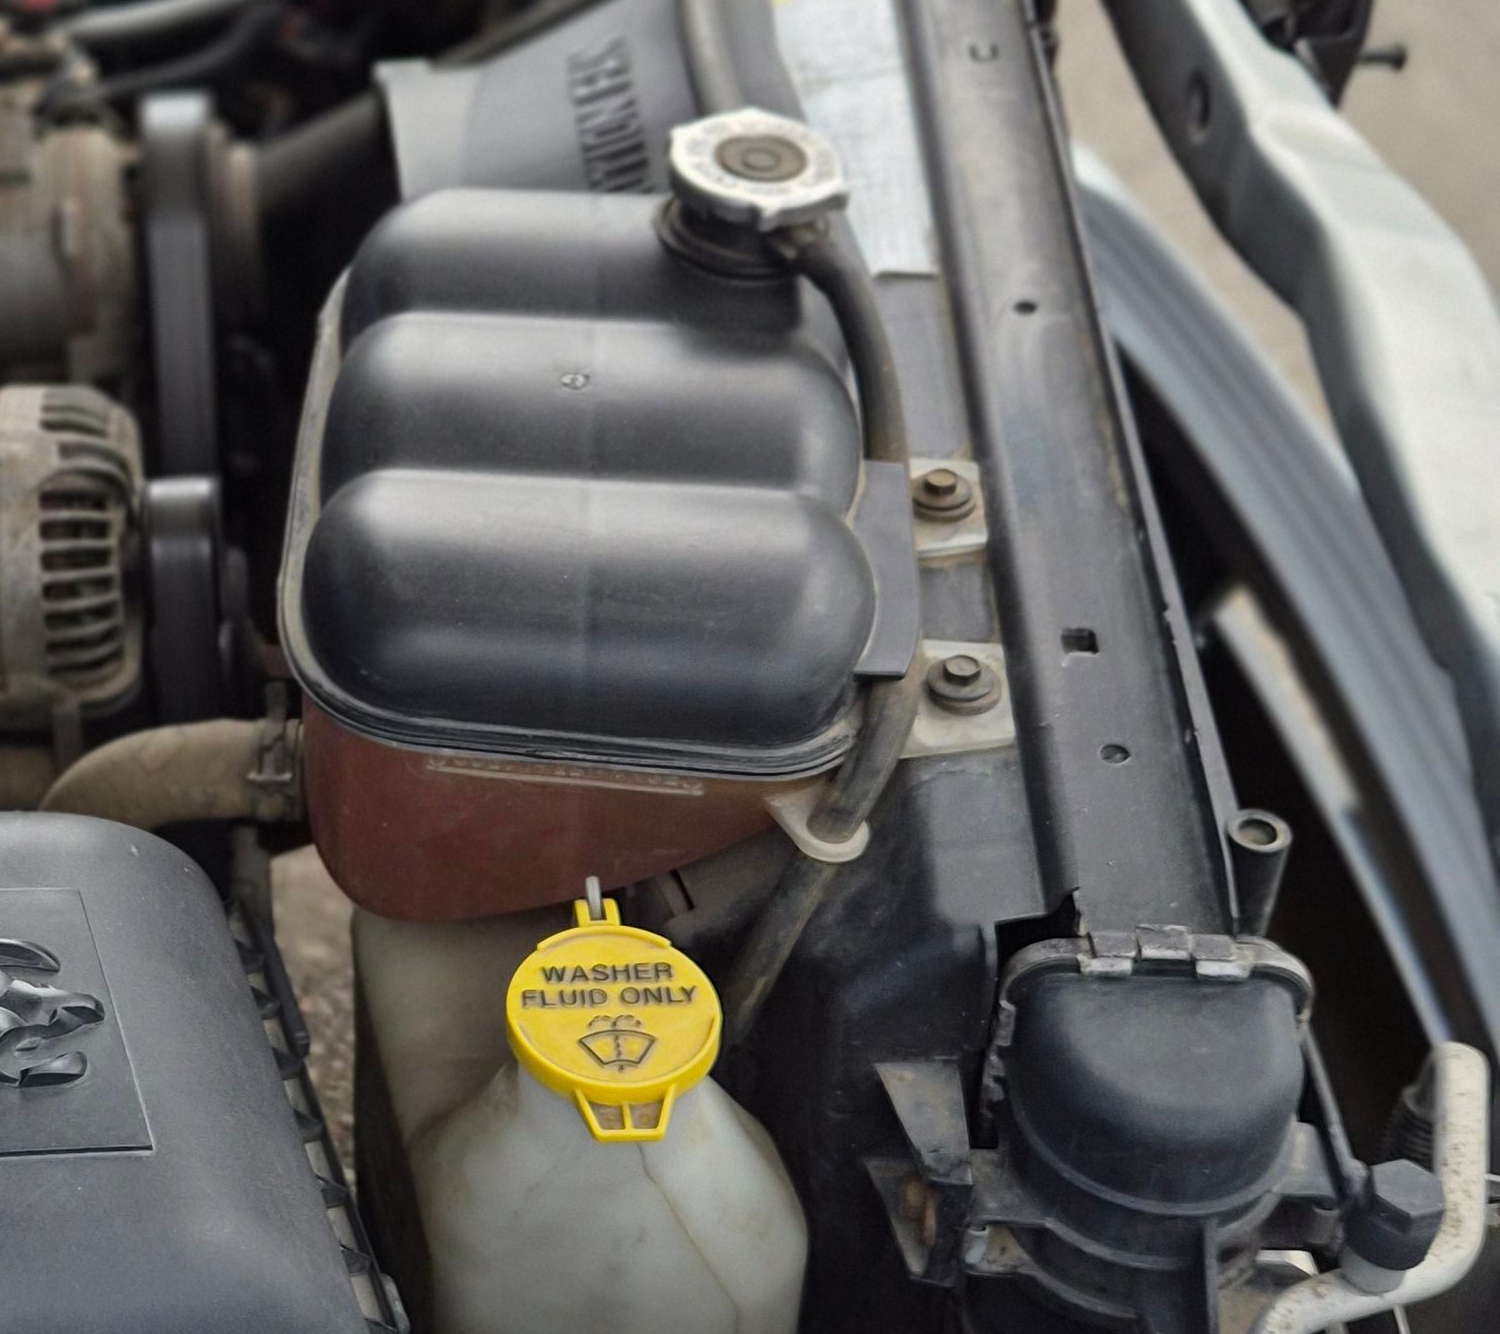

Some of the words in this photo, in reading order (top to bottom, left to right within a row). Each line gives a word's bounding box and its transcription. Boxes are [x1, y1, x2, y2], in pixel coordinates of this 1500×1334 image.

[540, 961, 674, 983] WASHER
[520, 987, 608, 1009] FLUID
[619, 985, 698, 1007] ONLY
